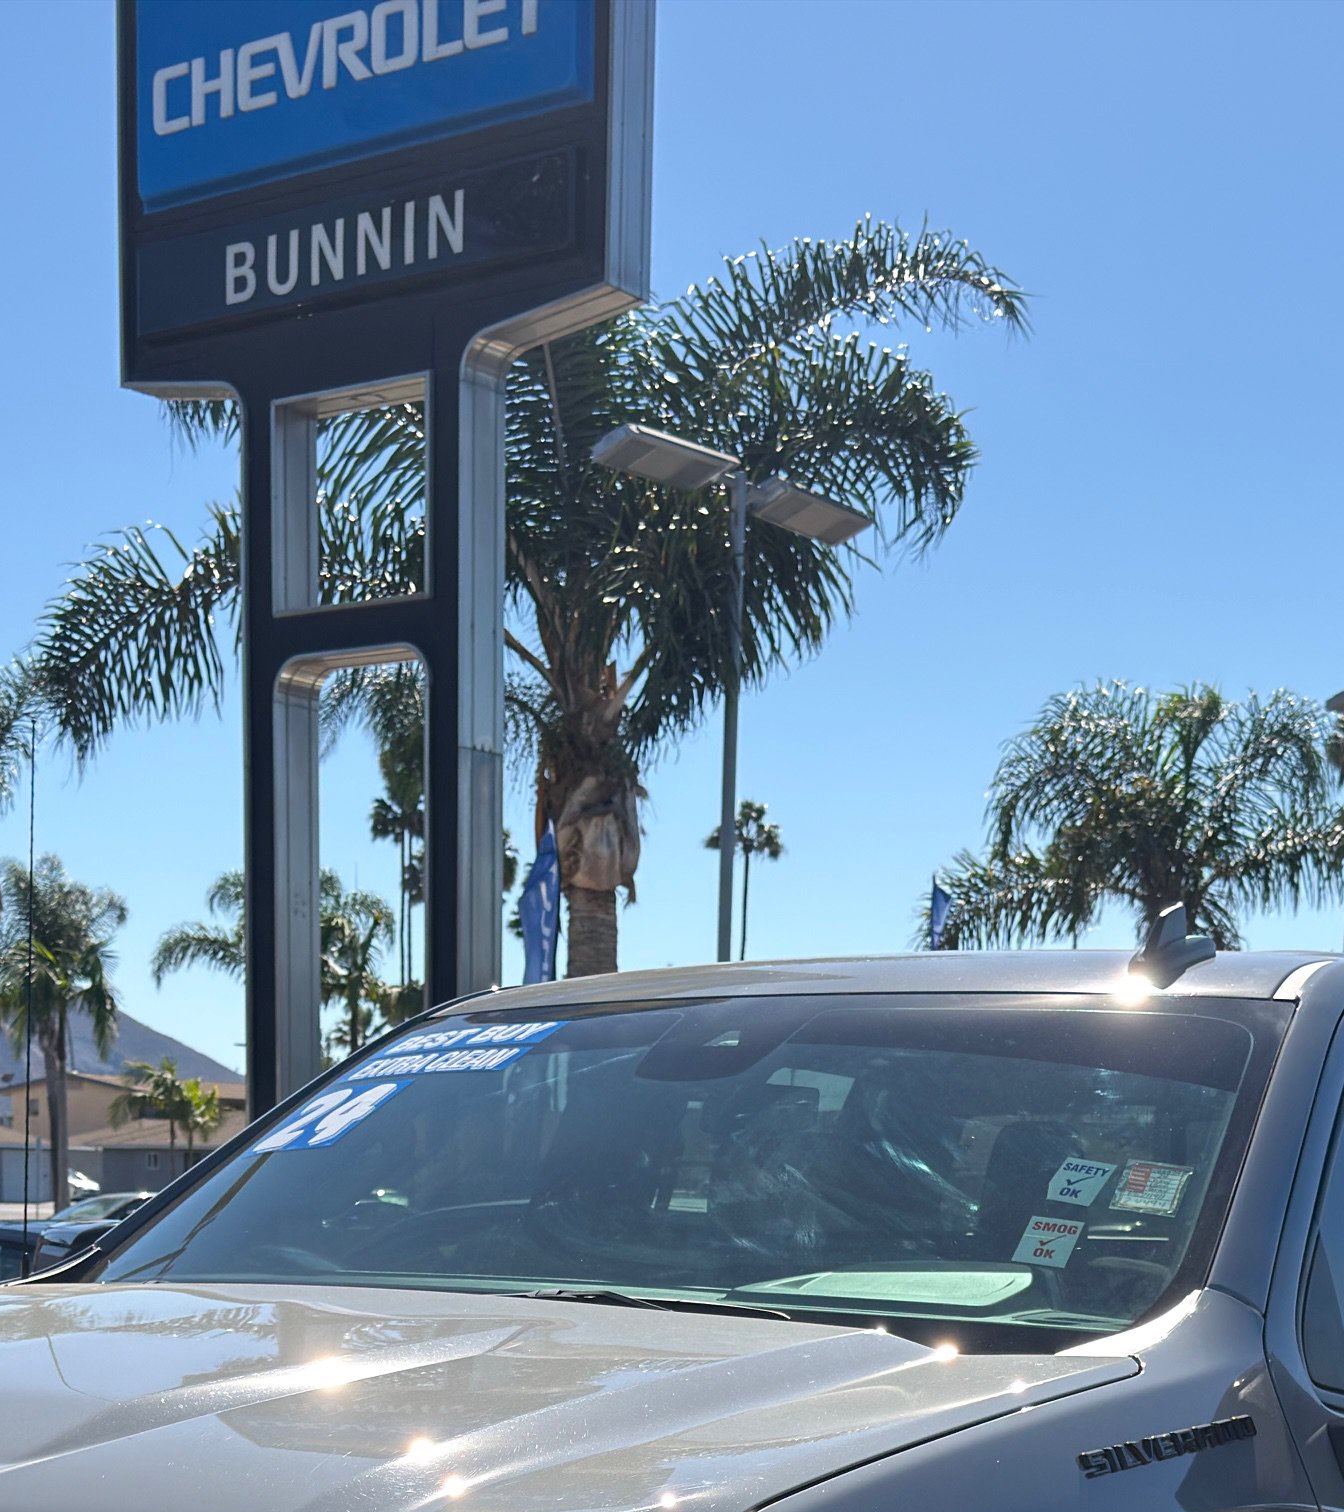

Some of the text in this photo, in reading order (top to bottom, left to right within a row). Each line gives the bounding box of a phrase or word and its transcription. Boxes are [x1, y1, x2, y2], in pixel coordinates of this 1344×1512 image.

[224, 189, 465, 306] BUNNIN
[384, 1021, 558, 1055] BEST BUY
[348, 1047, 521, 1081] EXTRA CLEAN
[252, 1083, 398, 1152] 24
[1062, 1162, 1110, 1177] SAFETY
[1059, 1187, 1082, 1199] OK
[1032, 1220, 1078, 1235] SMOG
[1032, 1247, 1056, 1259] OK
